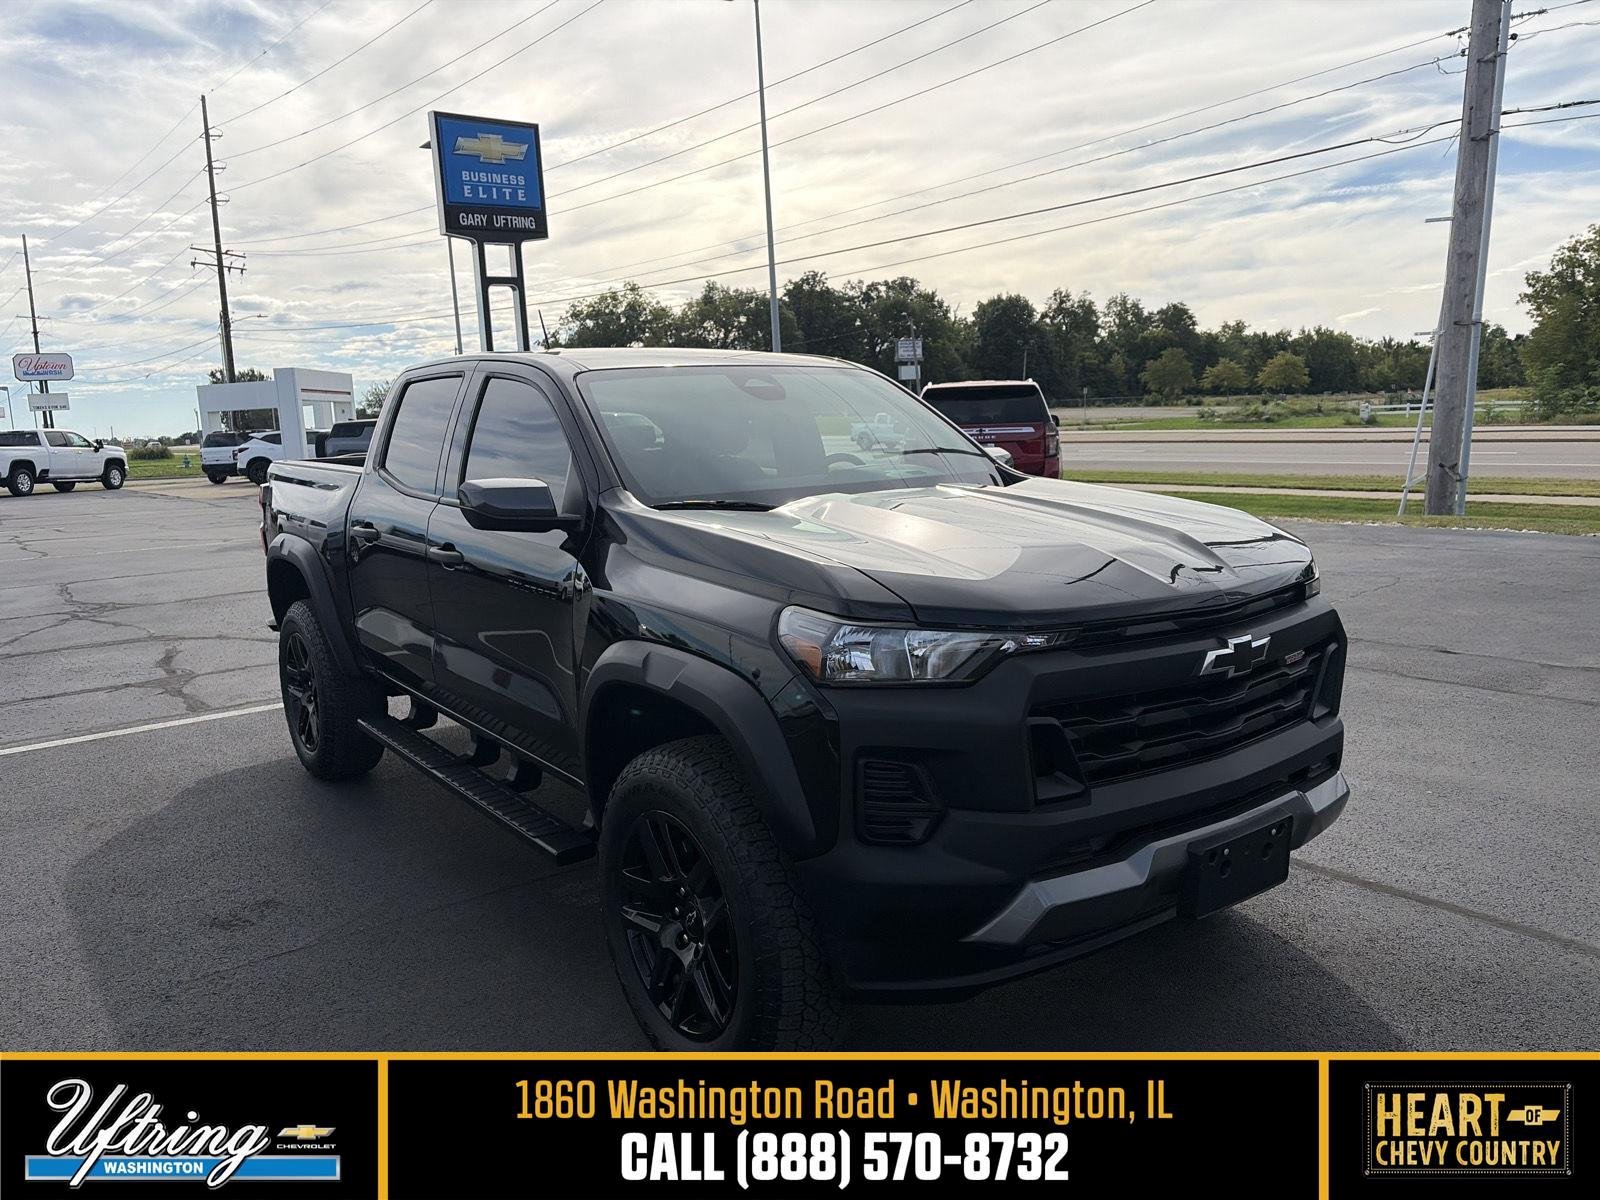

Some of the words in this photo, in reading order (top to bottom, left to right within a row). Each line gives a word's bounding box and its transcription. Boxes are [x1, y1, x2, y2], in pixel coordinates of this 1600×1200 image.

[462, 170, 525, 185] BUSINESS
[463, 185, 526, 201] ELITE
[459, 213, 488, 227] GARY
[493, 215, 536, 229] UFTRING
[18, 357, 66, 372] Uptown
